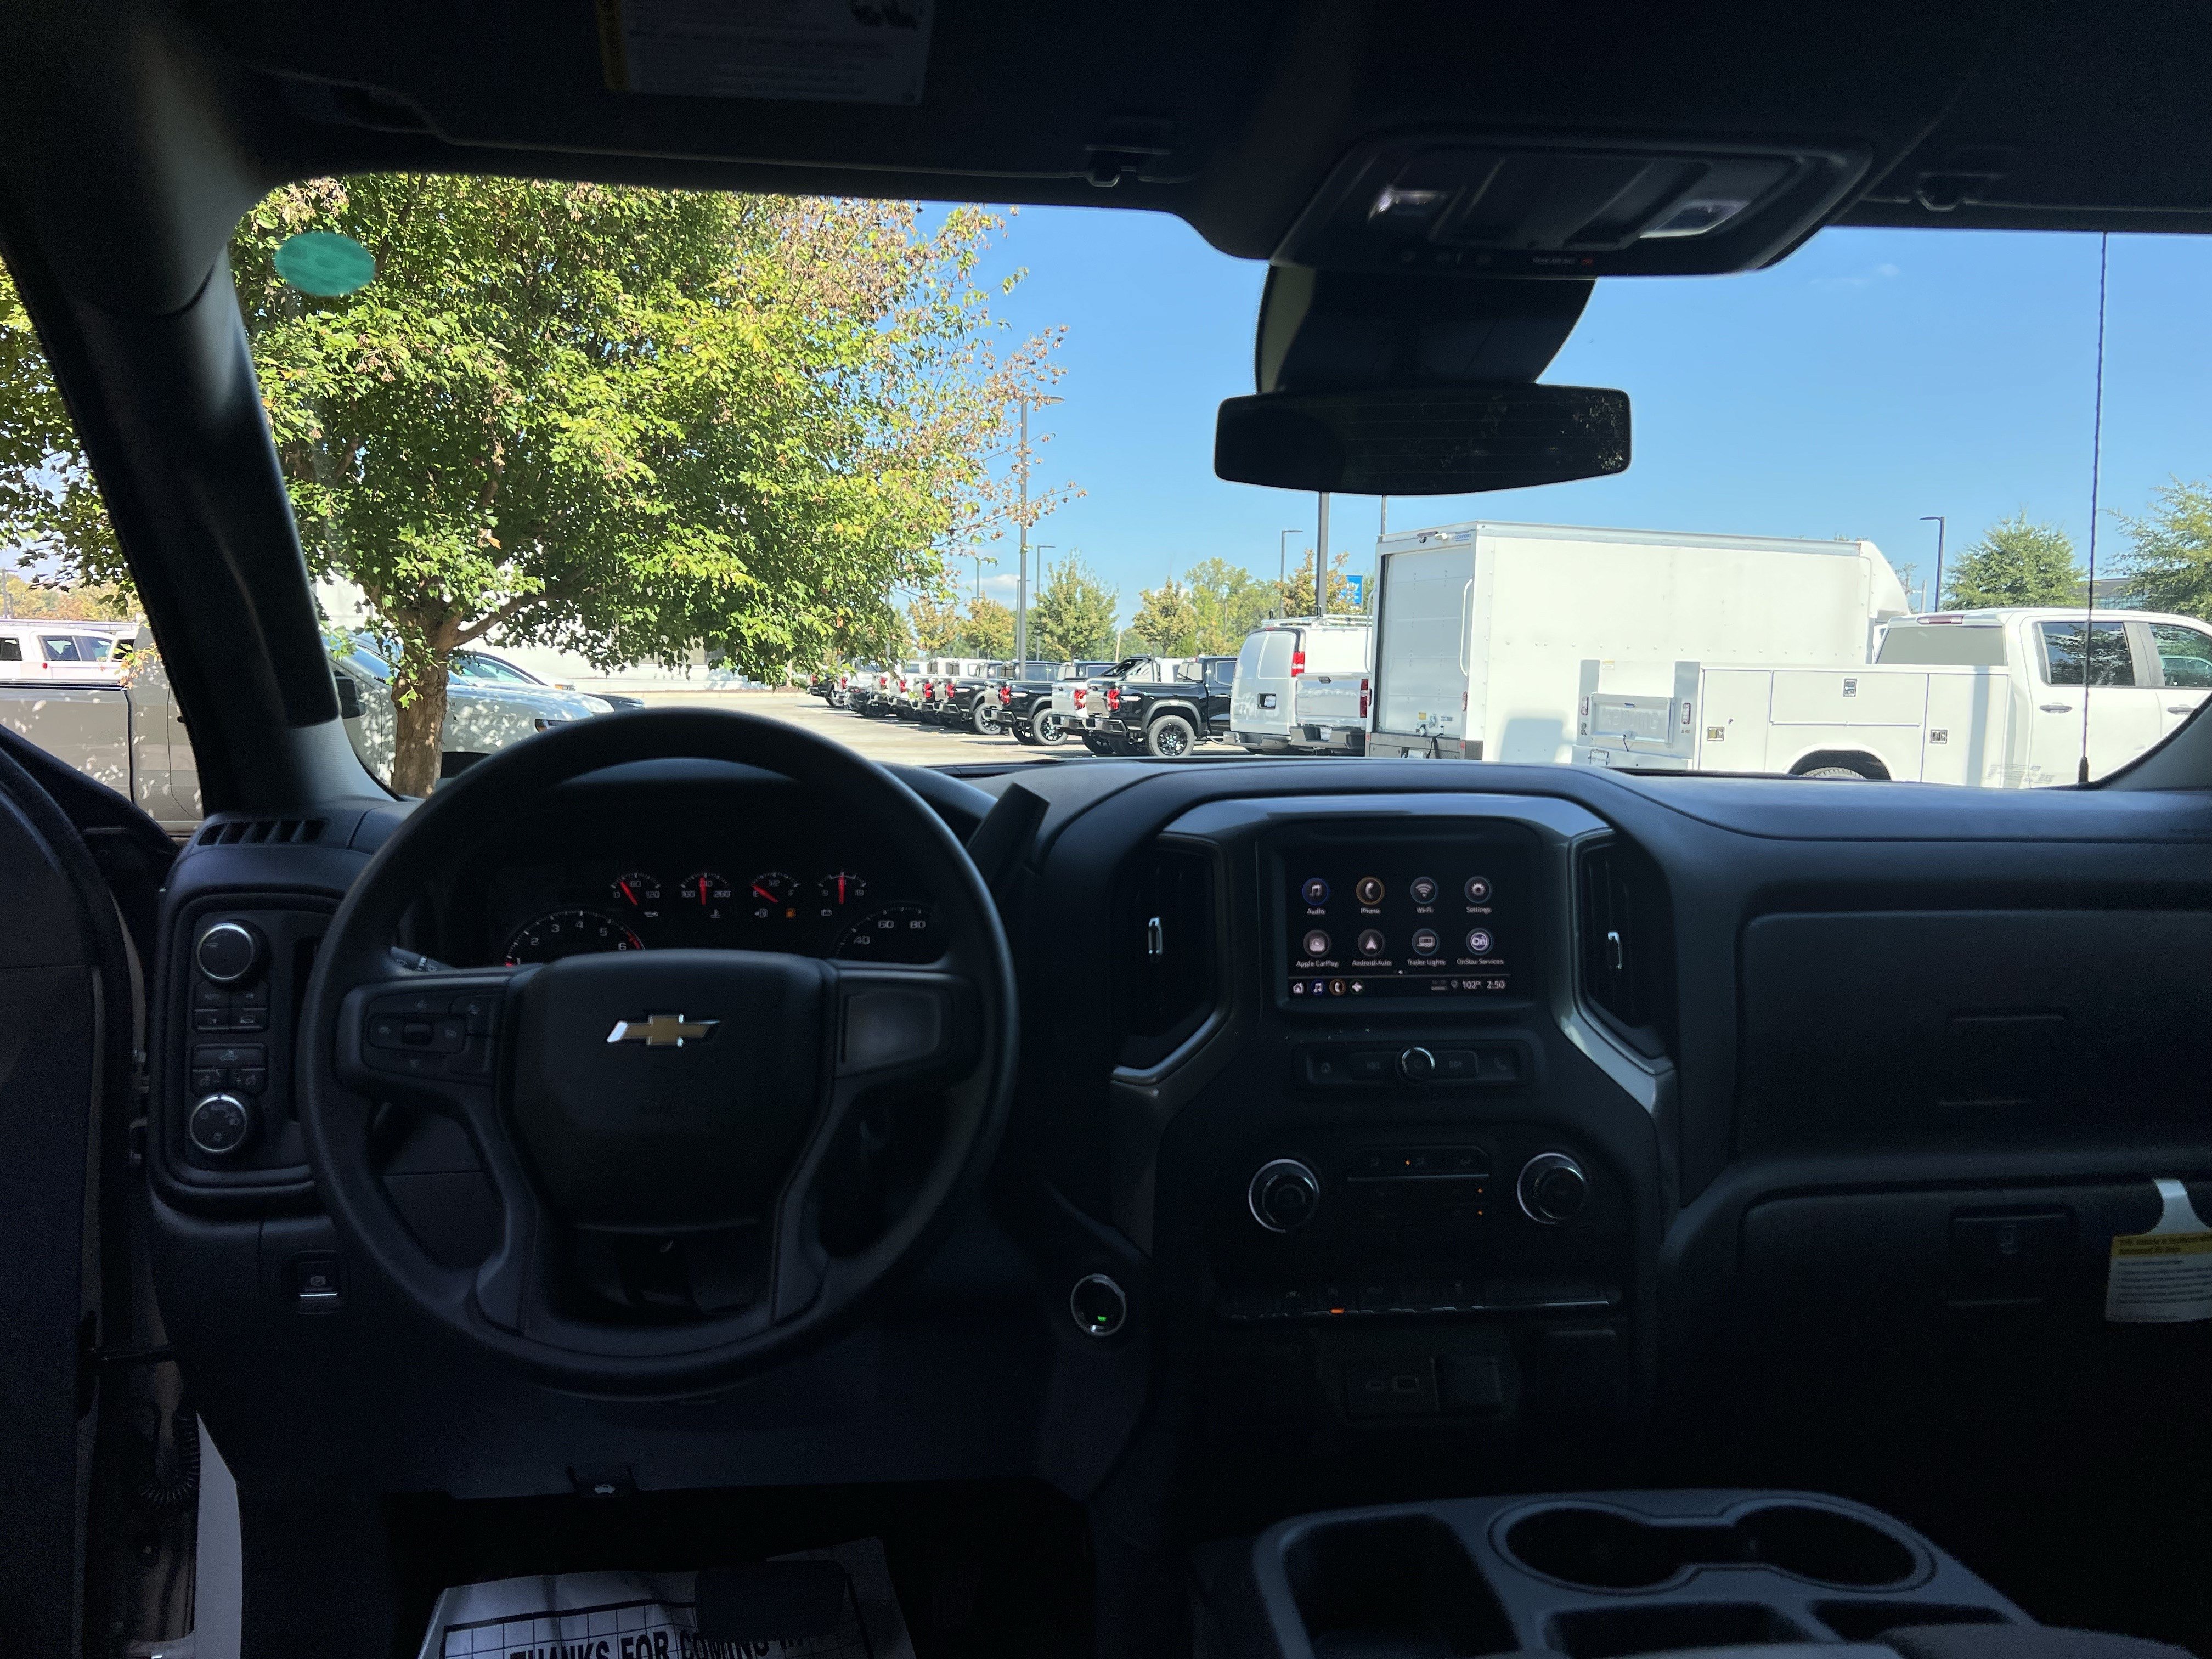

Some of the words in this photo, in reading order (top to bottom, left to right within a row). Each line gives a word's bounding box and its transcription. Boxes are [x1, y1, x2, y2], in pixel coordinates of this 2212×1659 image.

[600, 928, 607, 936] 5
[854, 936, 870, 944] 40
[620, 1630, 669, 1659] FOR
